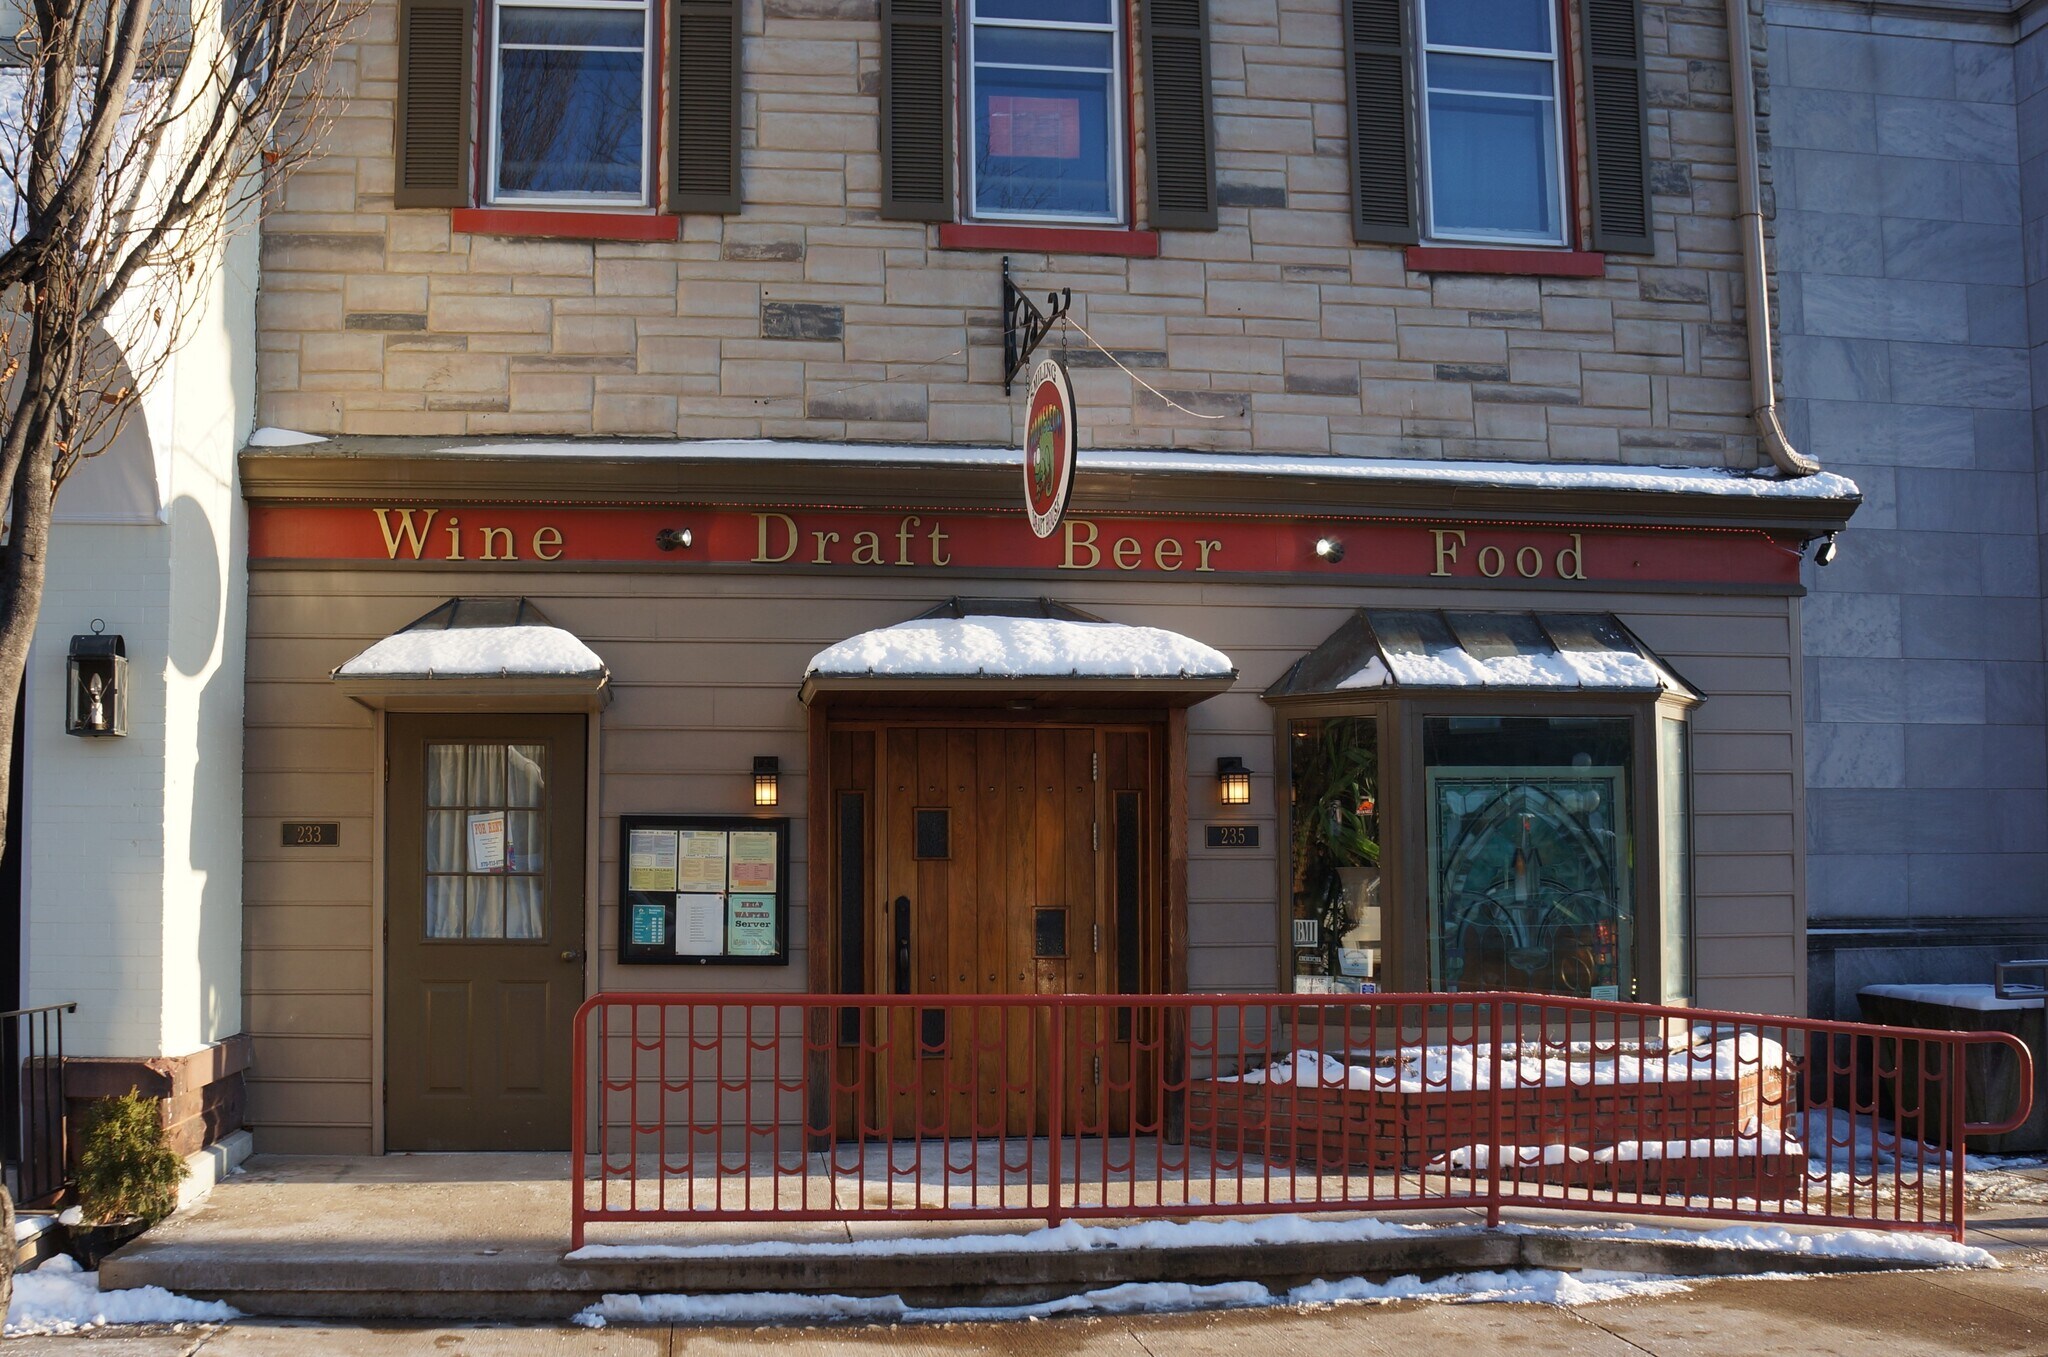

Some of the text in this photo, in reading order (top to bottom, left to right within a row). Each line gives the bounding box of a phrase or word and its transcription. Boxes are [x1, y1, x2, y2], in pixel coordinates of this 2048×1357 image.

[373, 509, 1588, 580] Wine Draft Beer Food
[297, 826, 321, 843] 233
[475, 821, 502, 835] FOR RENT
[1221, 828, 1245, 844] 235
[735, 920, 771, 928] Server
[1296, 921, 1316, 941] BMI
